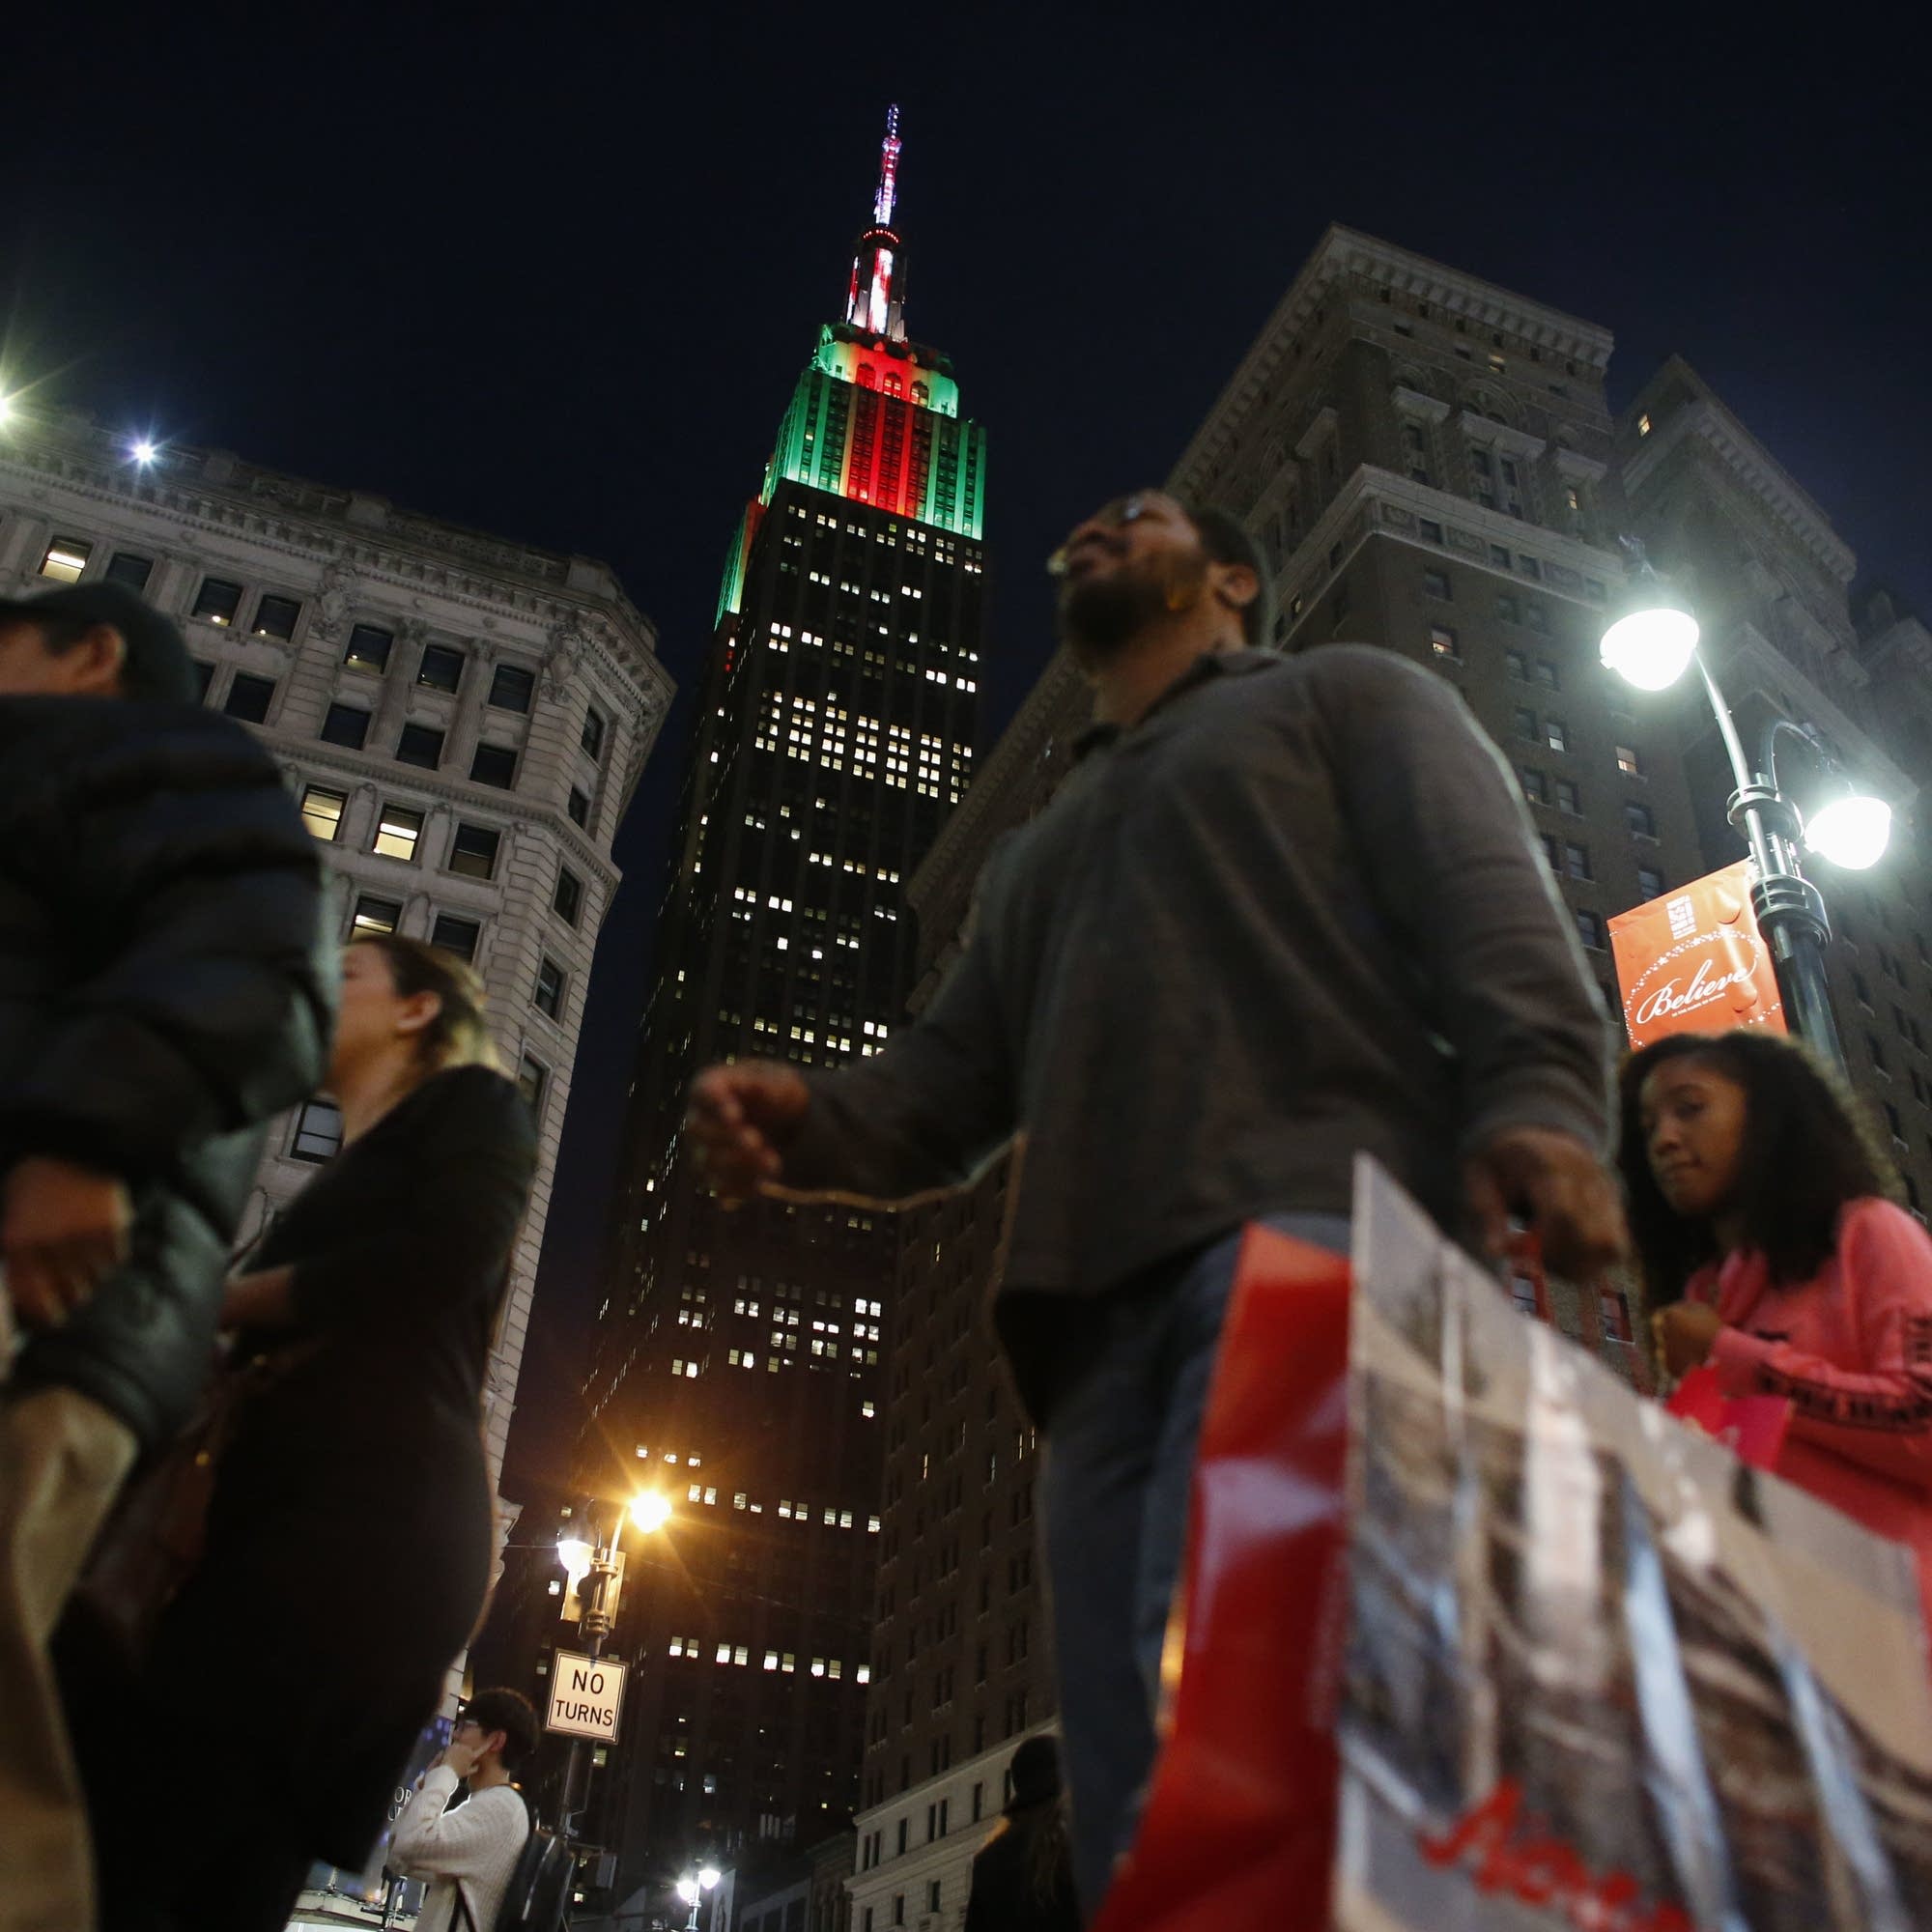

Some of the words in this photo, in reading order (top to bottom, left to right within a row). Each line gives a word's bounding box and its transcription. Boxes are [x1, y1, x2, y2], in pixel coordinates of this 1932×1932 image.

[1635, 958, 1757, 1024] Believe
[572, 1669, 605, 1694] NO
[555, 1699, 613, 1726] TURNS
